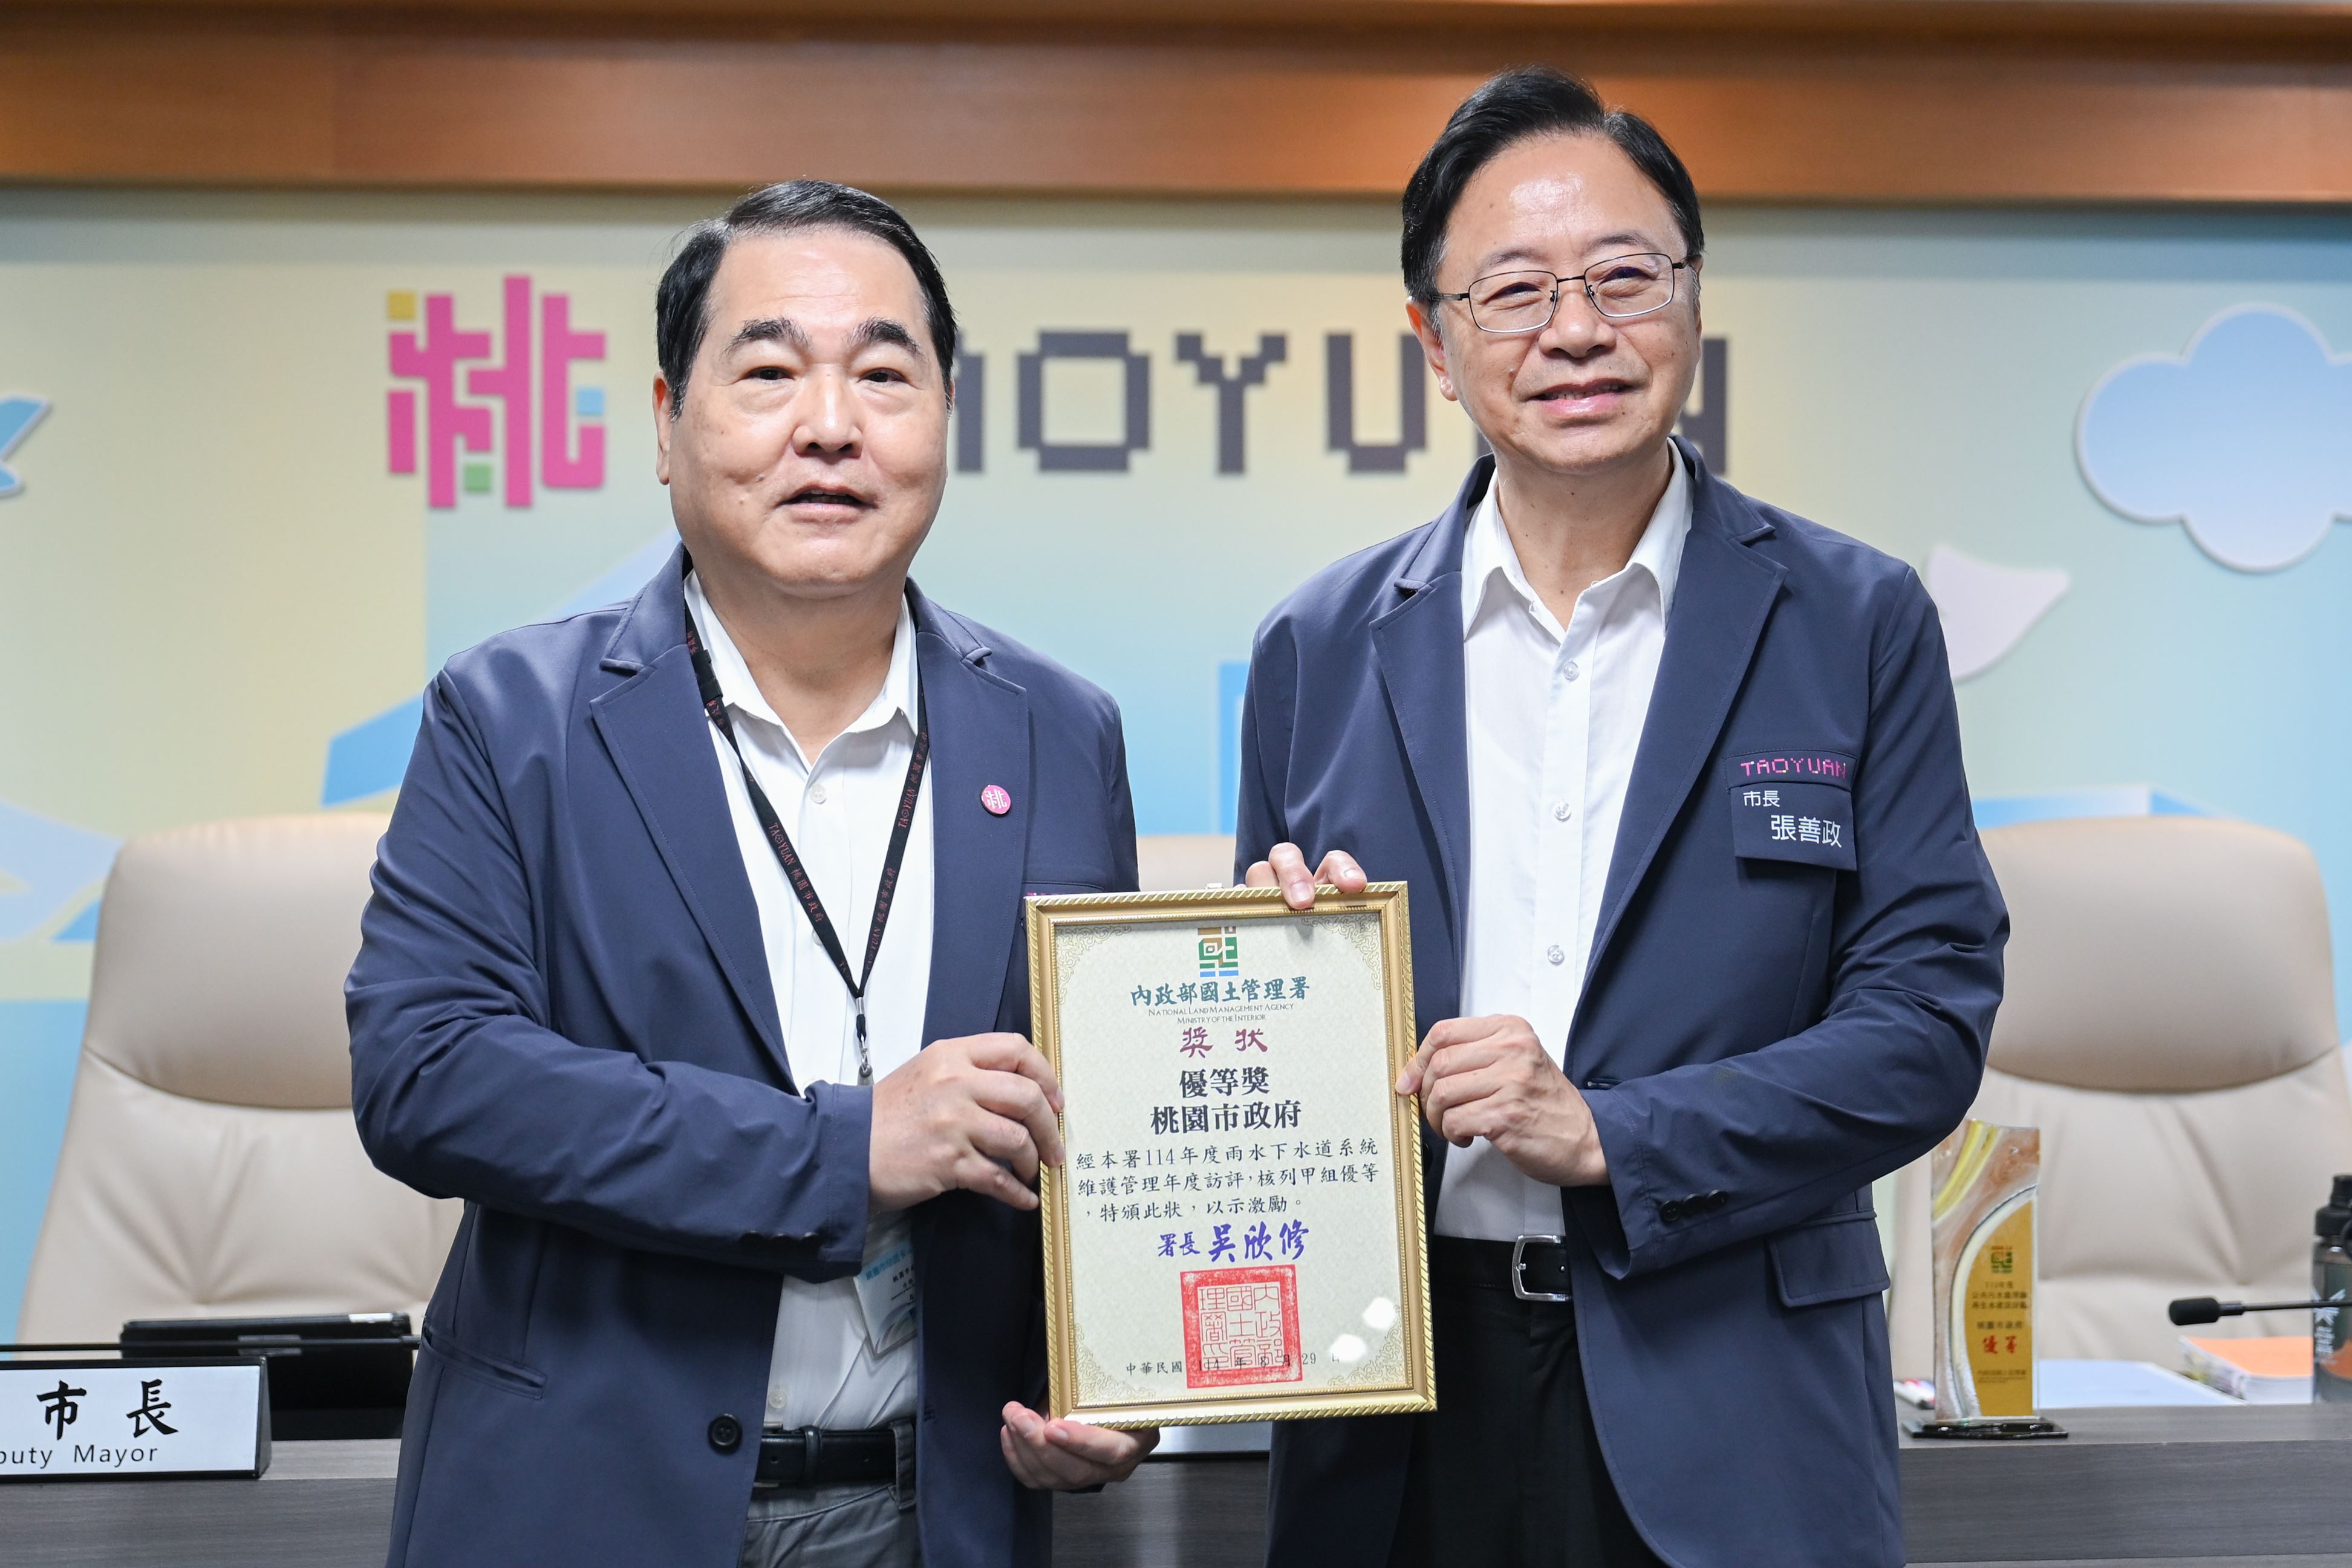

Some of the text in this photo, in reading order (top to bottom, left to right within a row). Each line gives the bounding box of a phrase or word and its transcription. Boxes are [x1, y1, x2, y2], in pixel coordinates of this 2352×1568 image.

[1740, 758, 1847, 779] TAOYUAN
[1742, 790, 1780, 807] 市長
[1770, 815, 1842, 848] 張善政
[790, 868, 824, 923] 桃園市政府
[1130, 976, 1310, 1006] 內政部國土管理署
[1149, 1008, 1187, 1017] NATIONAL
[1210, 1004, 1263, 1013] MANAGEMENT
[1179, 1066, 1270, 1099] 優等獎
[1150, 1100, 1302, 1135] 桃園市政府
[1158, 1218, 1309, 1263] 署長 吳欣修
[1126, 1361, 1184, 1377] 中華民國
[1302, 1353, 1317, 1365] 29
[36, 1379, 178, 1440] 市長
[74, 1444, 158, 1468] Mayor
